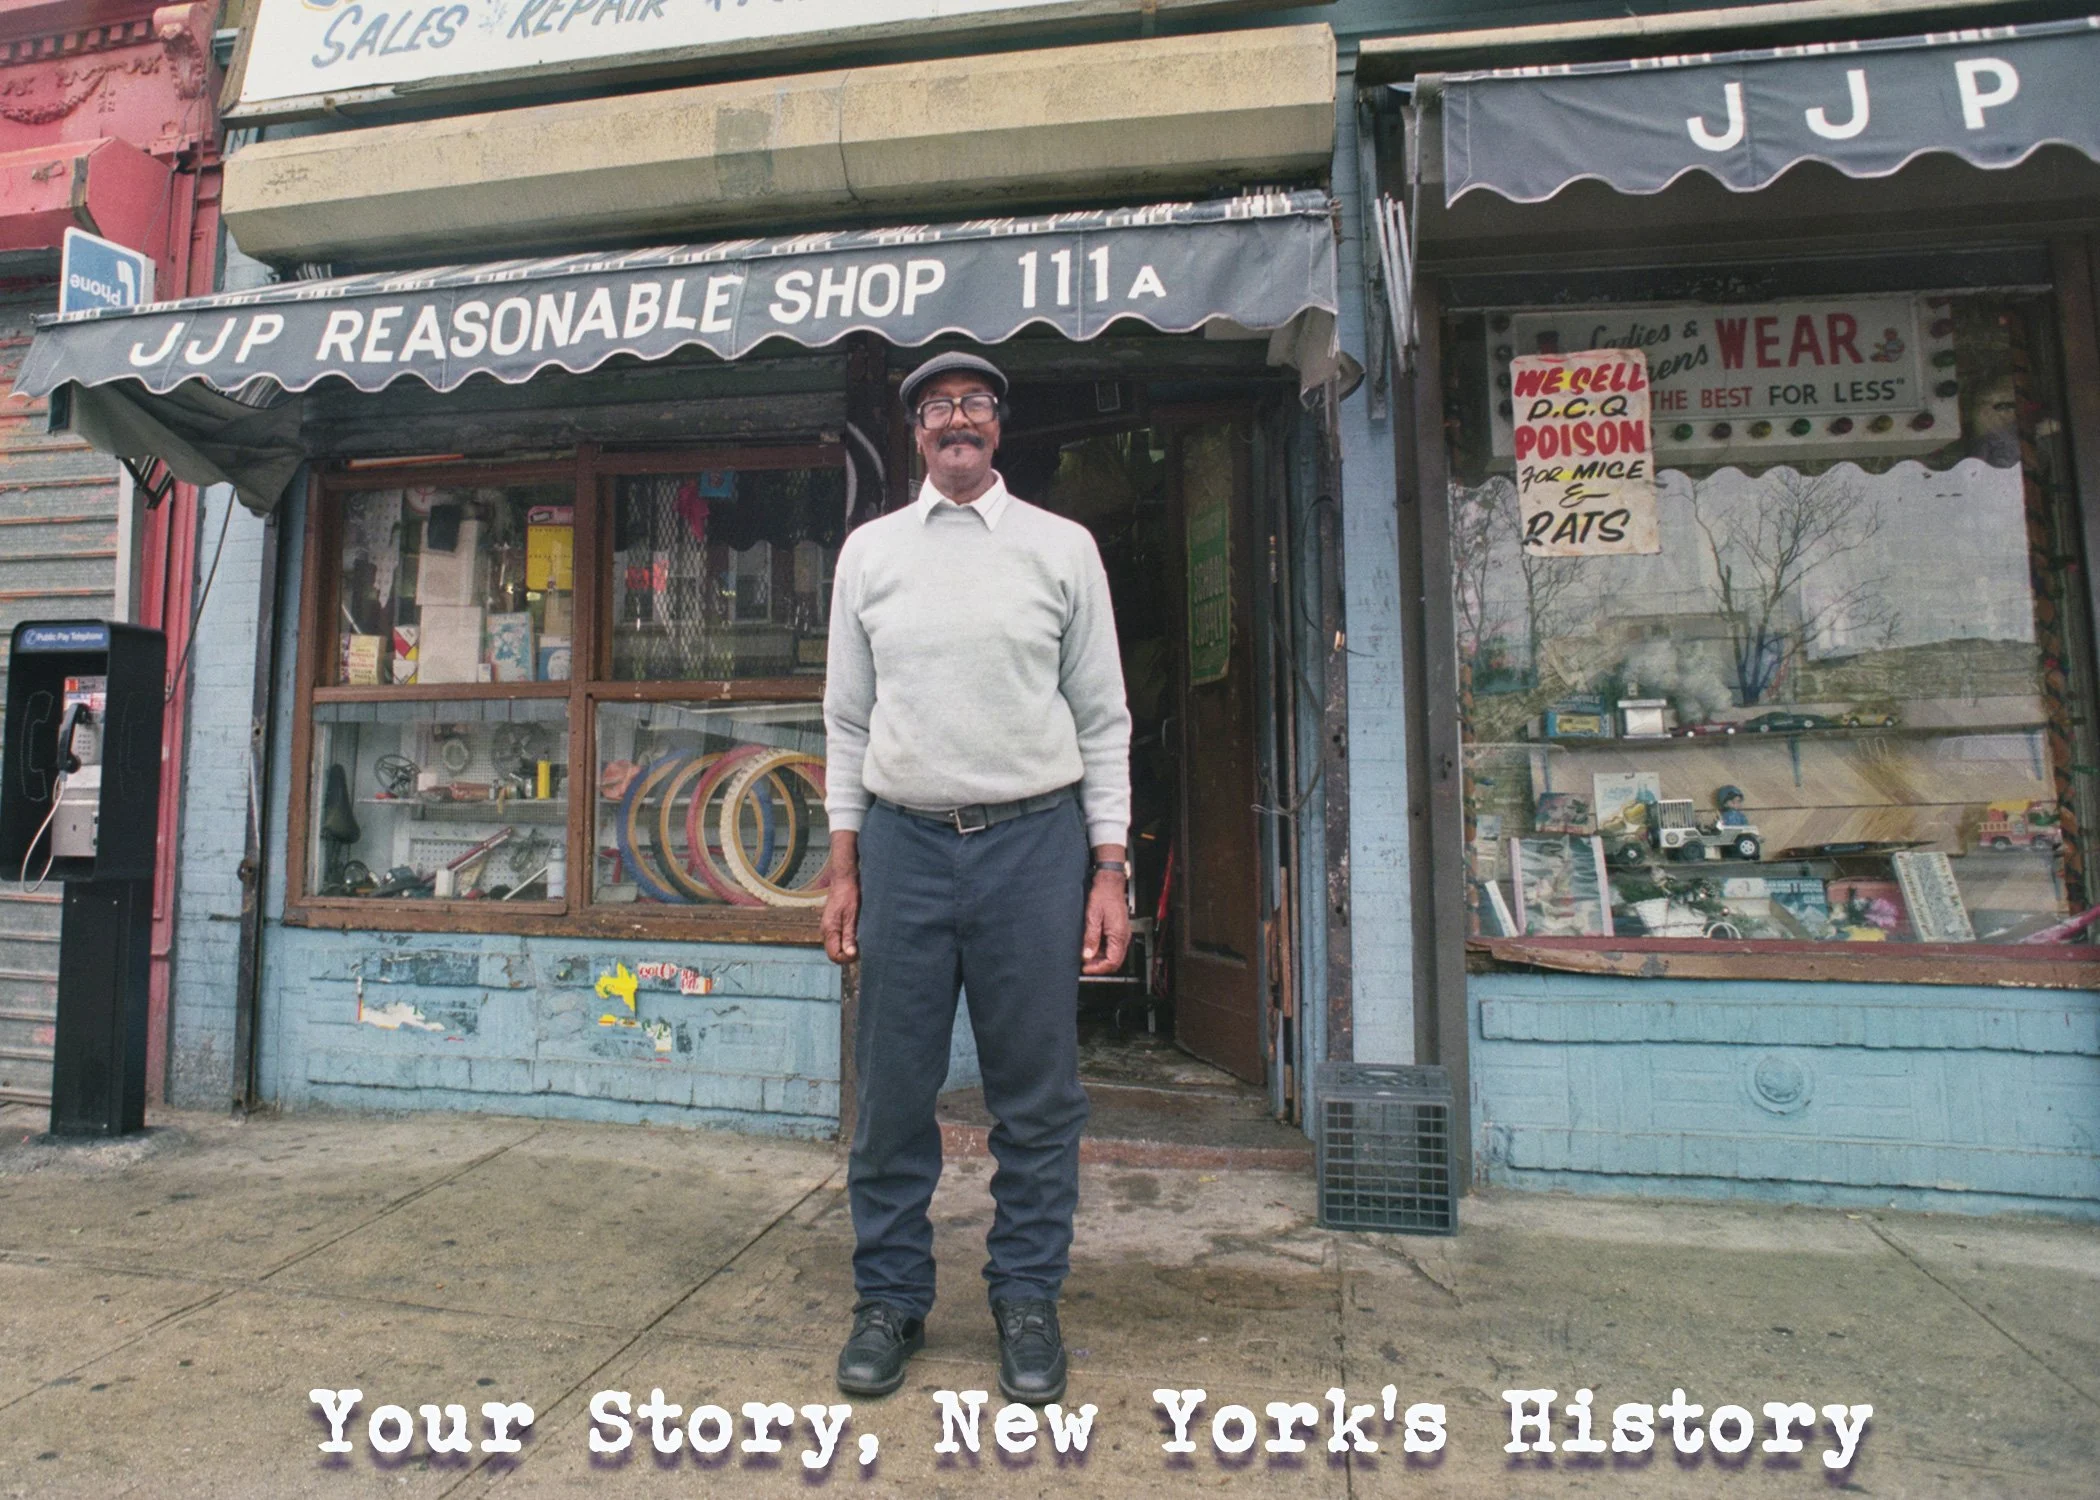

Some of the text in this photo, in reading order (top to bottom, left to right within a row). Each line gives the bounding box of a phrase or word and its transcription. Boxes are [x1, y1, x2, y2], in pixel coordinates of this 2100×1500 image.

[312, 4, 470, 69] SALES
[69, 273, 122, 307] Phone
[316, 275, 744, 362] REASONABLE
[769, 259, 945, 325] SHOP
[1683, 320, 1698, 339] &
[1715, 312, 1863, 370] WEAR
[1514, 362, 1646, 398] WE SELL
[1650, 389, 1688, 411] THE
[1701, 386, 1753, 409] BEST
[1768, 383, 1819, 407] FOR
[1514, 420, 1646, 460] POISON
[1571, 460, 1646, 480] MICE
[1521, 508, 1631, 546] RATS
